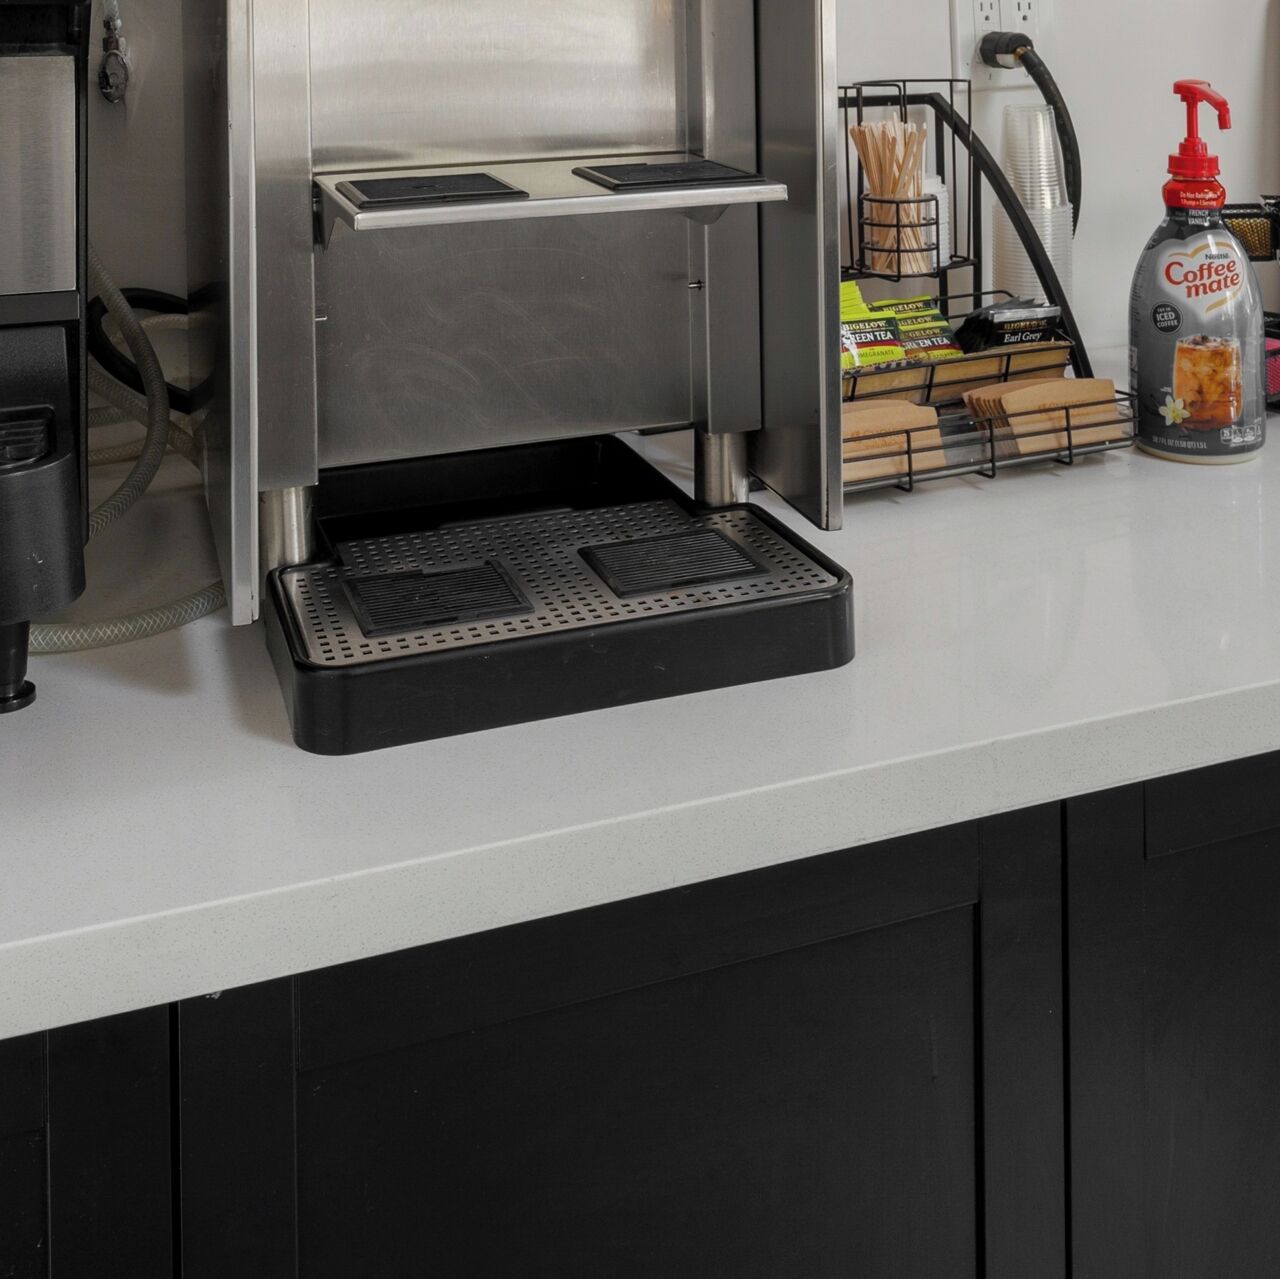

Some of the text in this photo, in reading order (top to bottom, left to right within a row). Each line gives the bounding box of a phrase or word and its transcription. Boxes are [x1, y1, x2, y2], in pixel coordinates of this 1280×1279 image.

[1164, 260, 1236, 286] Coffee
[1185, 272, 1240, 298] mate
[1156, 312, 1175, 322] ICED
[1157, 320, 1178, 328] COFFEE
[875, 330, 894, 341] TEA
[933, 336, 951, 346] TEA
[1004, 331, 1042, 343] Earl Grey
